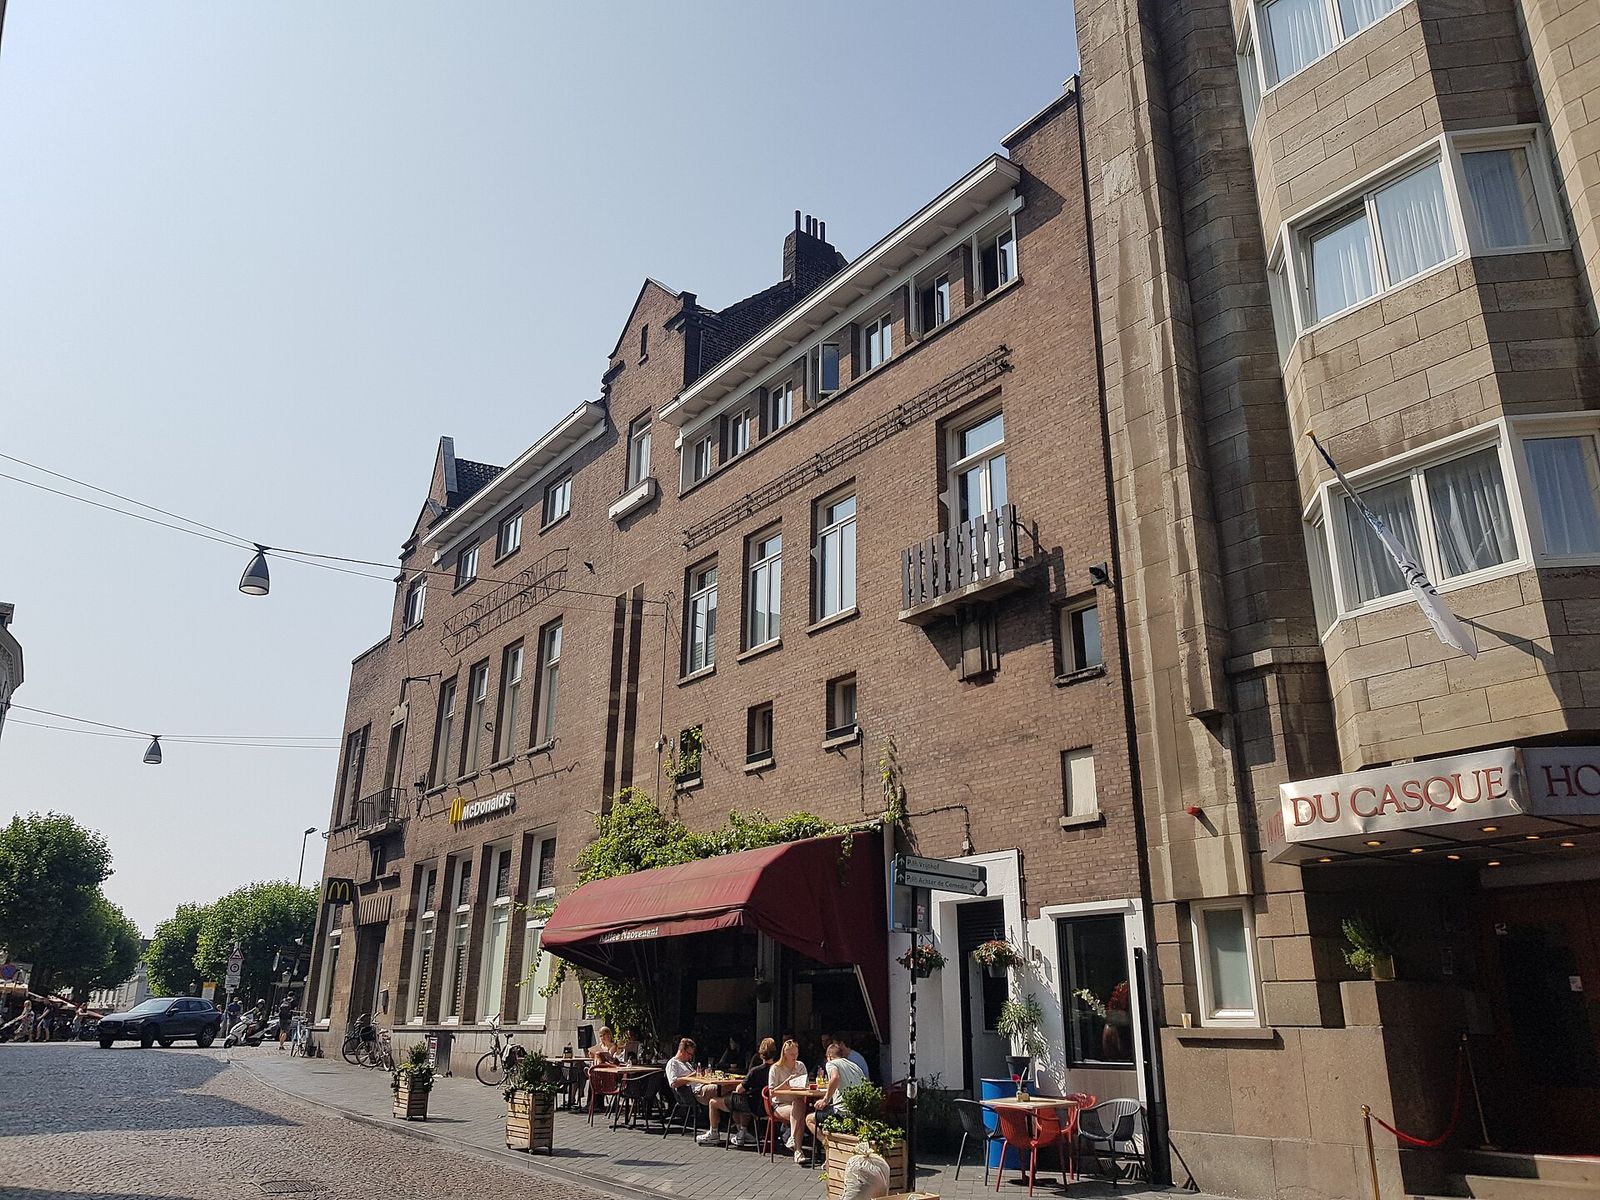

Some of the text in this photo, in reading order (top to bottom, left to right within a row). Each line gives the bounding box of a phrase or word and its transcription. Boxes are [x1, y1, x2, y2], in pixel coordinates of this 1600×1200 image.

[462, 792, 513, 820] McDonald's
[1290, 766, 1509, 827] DU CASQUE
